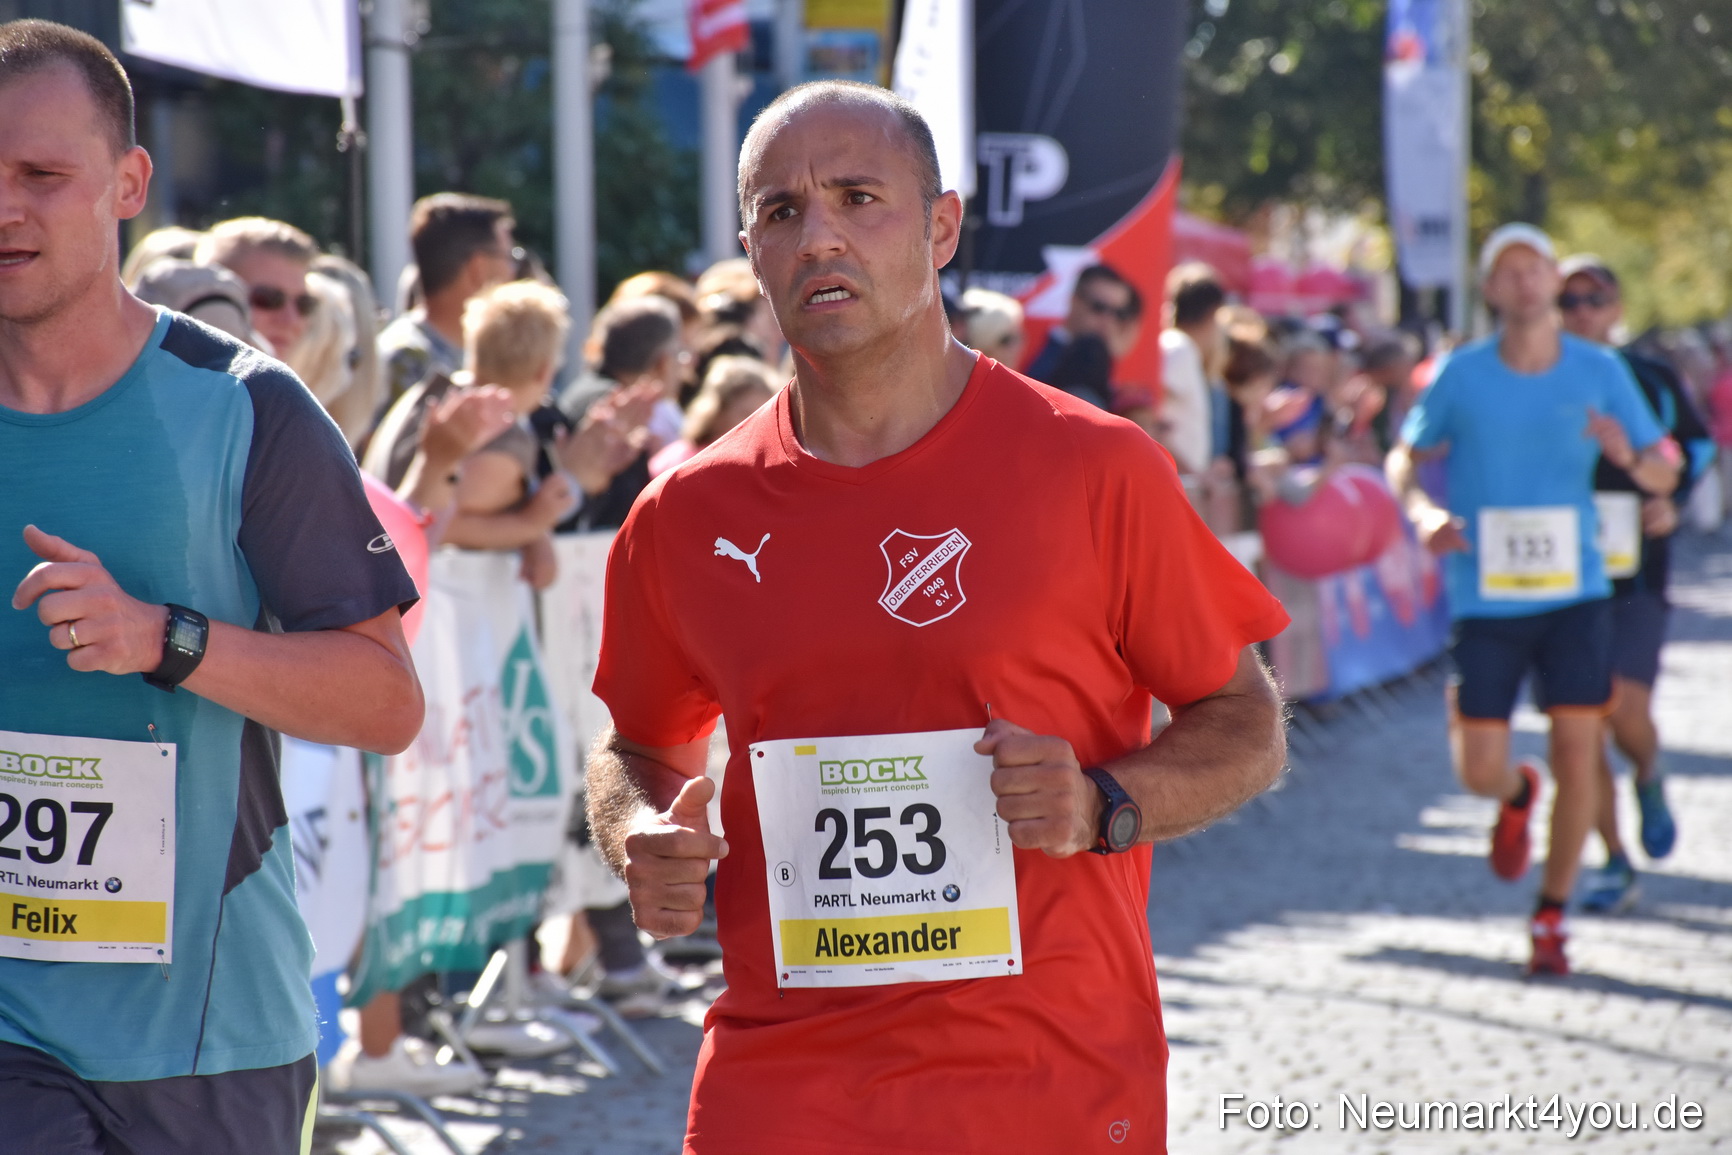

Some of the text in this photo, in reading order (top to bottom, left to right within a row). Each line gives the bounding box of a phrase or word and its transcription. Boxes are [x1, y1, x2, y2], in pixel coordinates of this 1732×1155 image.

[899, 547, 919, 568] FSV
[888, 537, 962, 606] OBERFERRIEDEN
[922, 577, 945, 597] 1949
[935, 590, 953, 607] e.V.
[0, 750, 103, 781] BOCK
[819, 756, 928, 785] BOCK
[0, 775, 26, 784] nspired
[28, 778, 38, 787] by
[39, 780, 63, 788] smart
[821, 782, 930, 796] inspired by smart concepts
[0, 793, 114, 865] 297
[814, 803, 947, 880] 253
[0, 870, 99, 890] RTL Neumarkt
[781, 868, 790, 881] B
[814, 889, 937, 908] PARTL Neumarkt
[11, 903, 78, 935] Felix
[815, 922, 962, 958] Alexander
